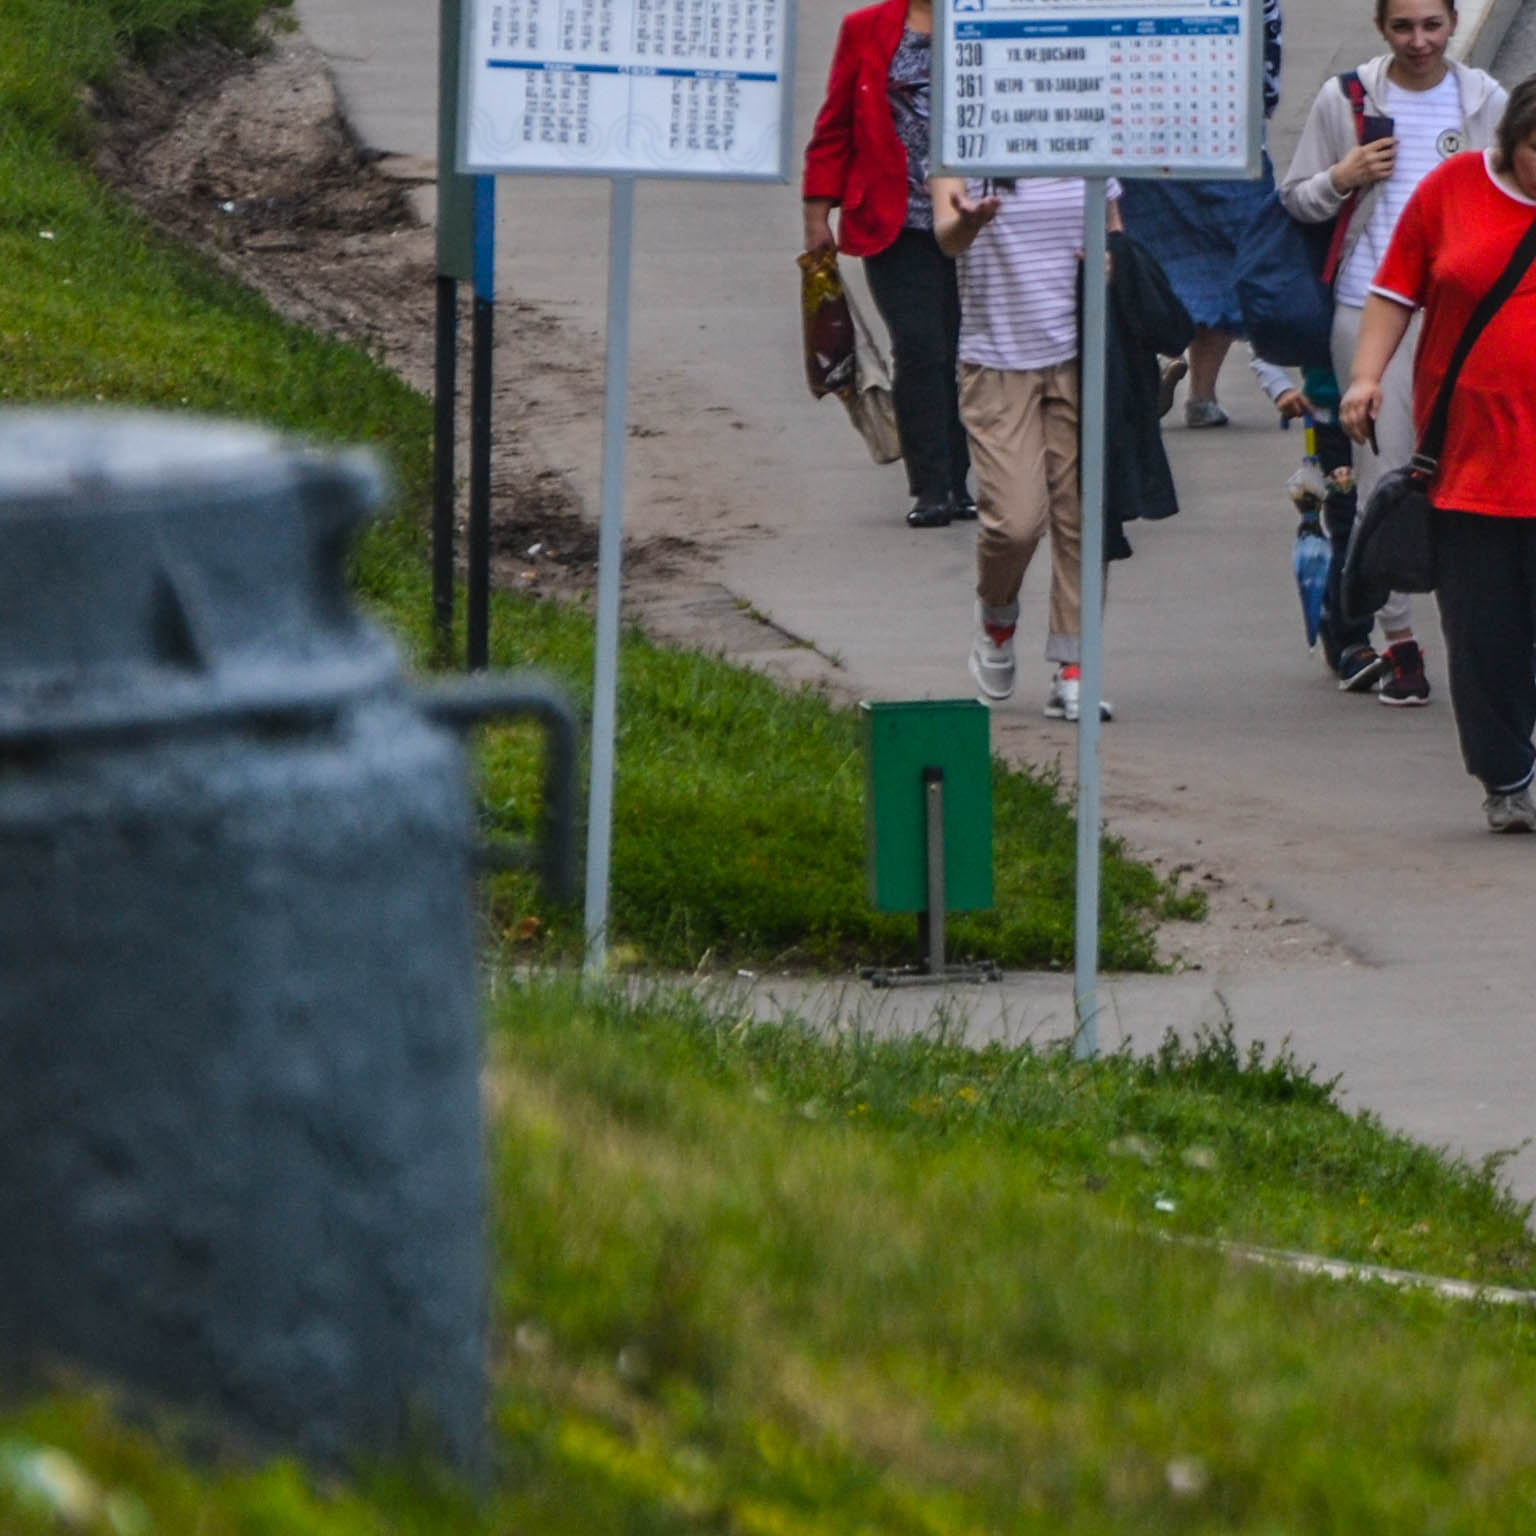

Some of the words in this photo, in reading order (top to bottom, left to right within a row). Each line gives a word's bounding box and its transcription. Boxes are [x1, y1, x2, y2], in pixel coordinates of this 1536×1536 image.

[955, 73, 984, 99] 361
[956, 104, 985, 129] 827
[957, 134, 986, 159] 977
